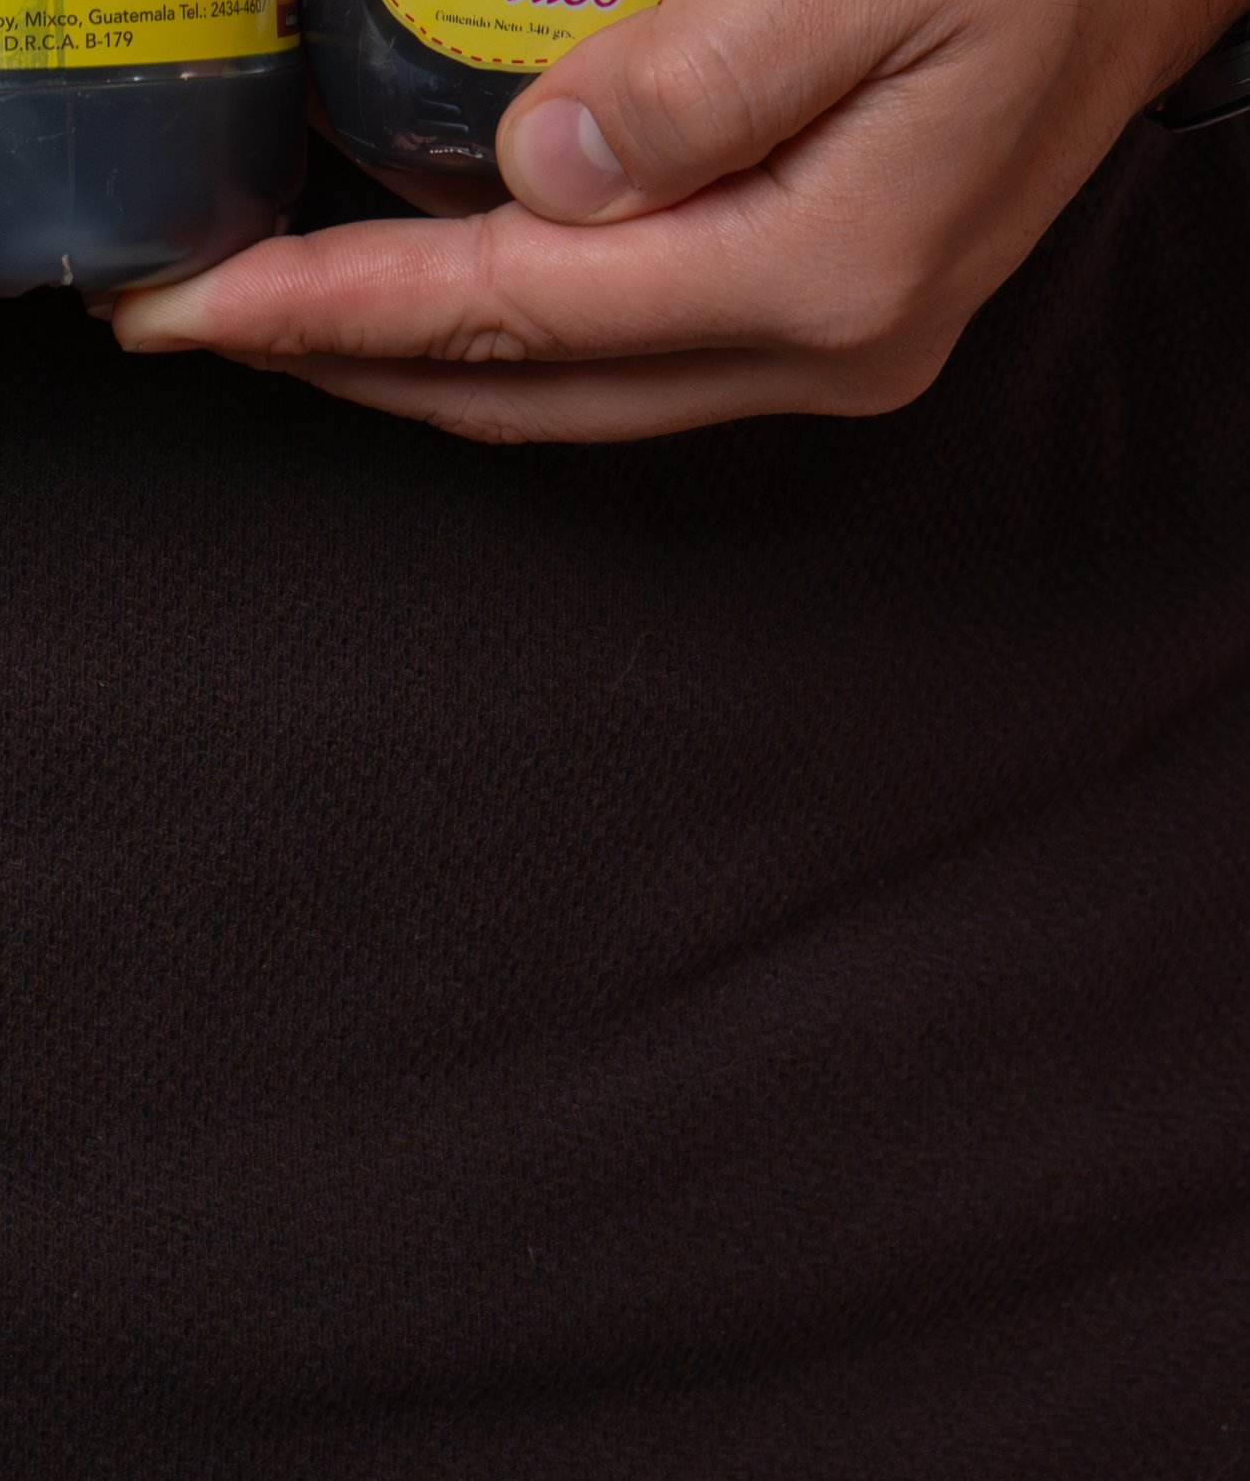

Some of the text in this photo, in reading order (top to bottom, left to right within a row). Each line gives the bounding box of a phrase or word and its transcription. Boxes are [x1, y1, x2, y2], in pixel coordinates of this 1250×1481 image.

[25, 11, 82, 28] Mixco,
[88, 5, 175, 25] Guatemala
[179, 3, 207, 20] Tel.:
[435, 10, 576, 40] Contenido Neto 340 grs.
[4, 34, 79, 52] D.R.C.A.
[85, 31, 133, 49] B-179
